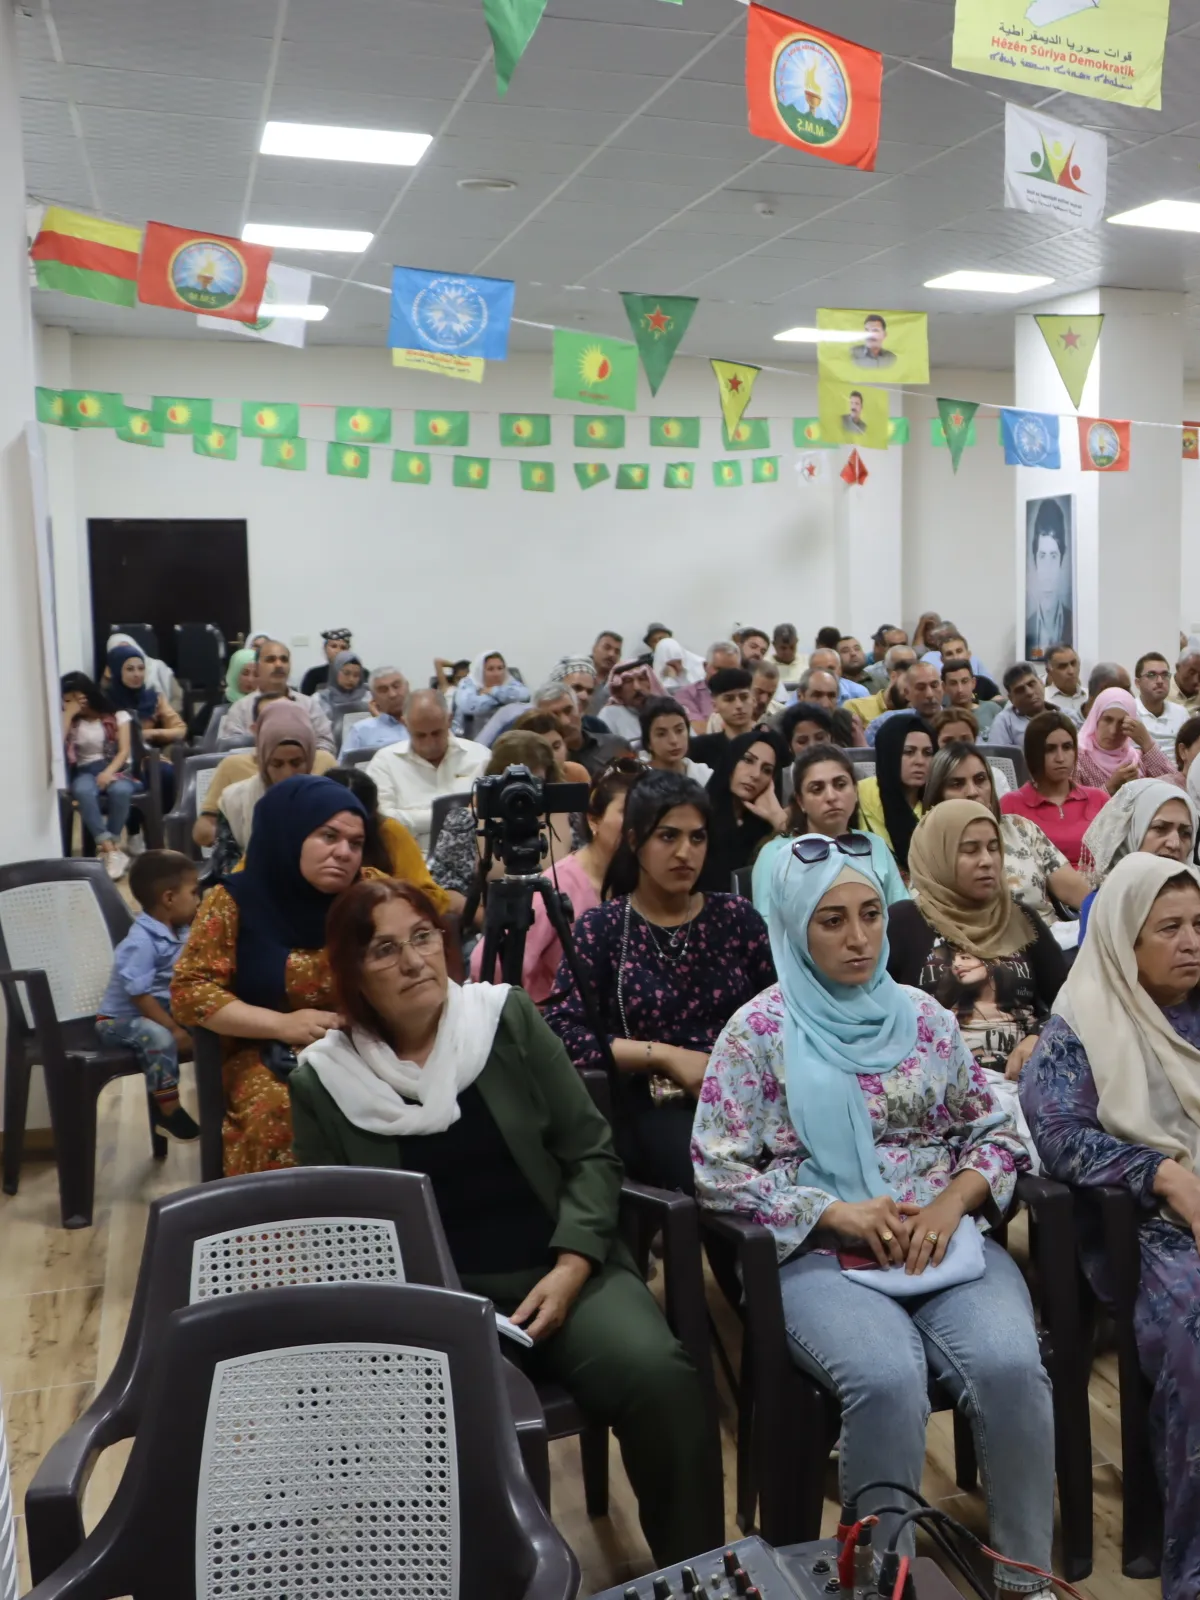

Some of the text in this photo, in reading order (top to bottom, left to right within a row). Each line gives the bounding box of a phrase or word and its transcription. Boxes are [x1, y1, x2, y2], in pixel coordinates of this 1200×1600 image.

[1065, 34, 1100, 54] سوريا
[990, 35, 1028, 53] Hêzên
[1068, 53, 1135, 78] Demokratîk
[1104, 48, 1133, 63] قوات
